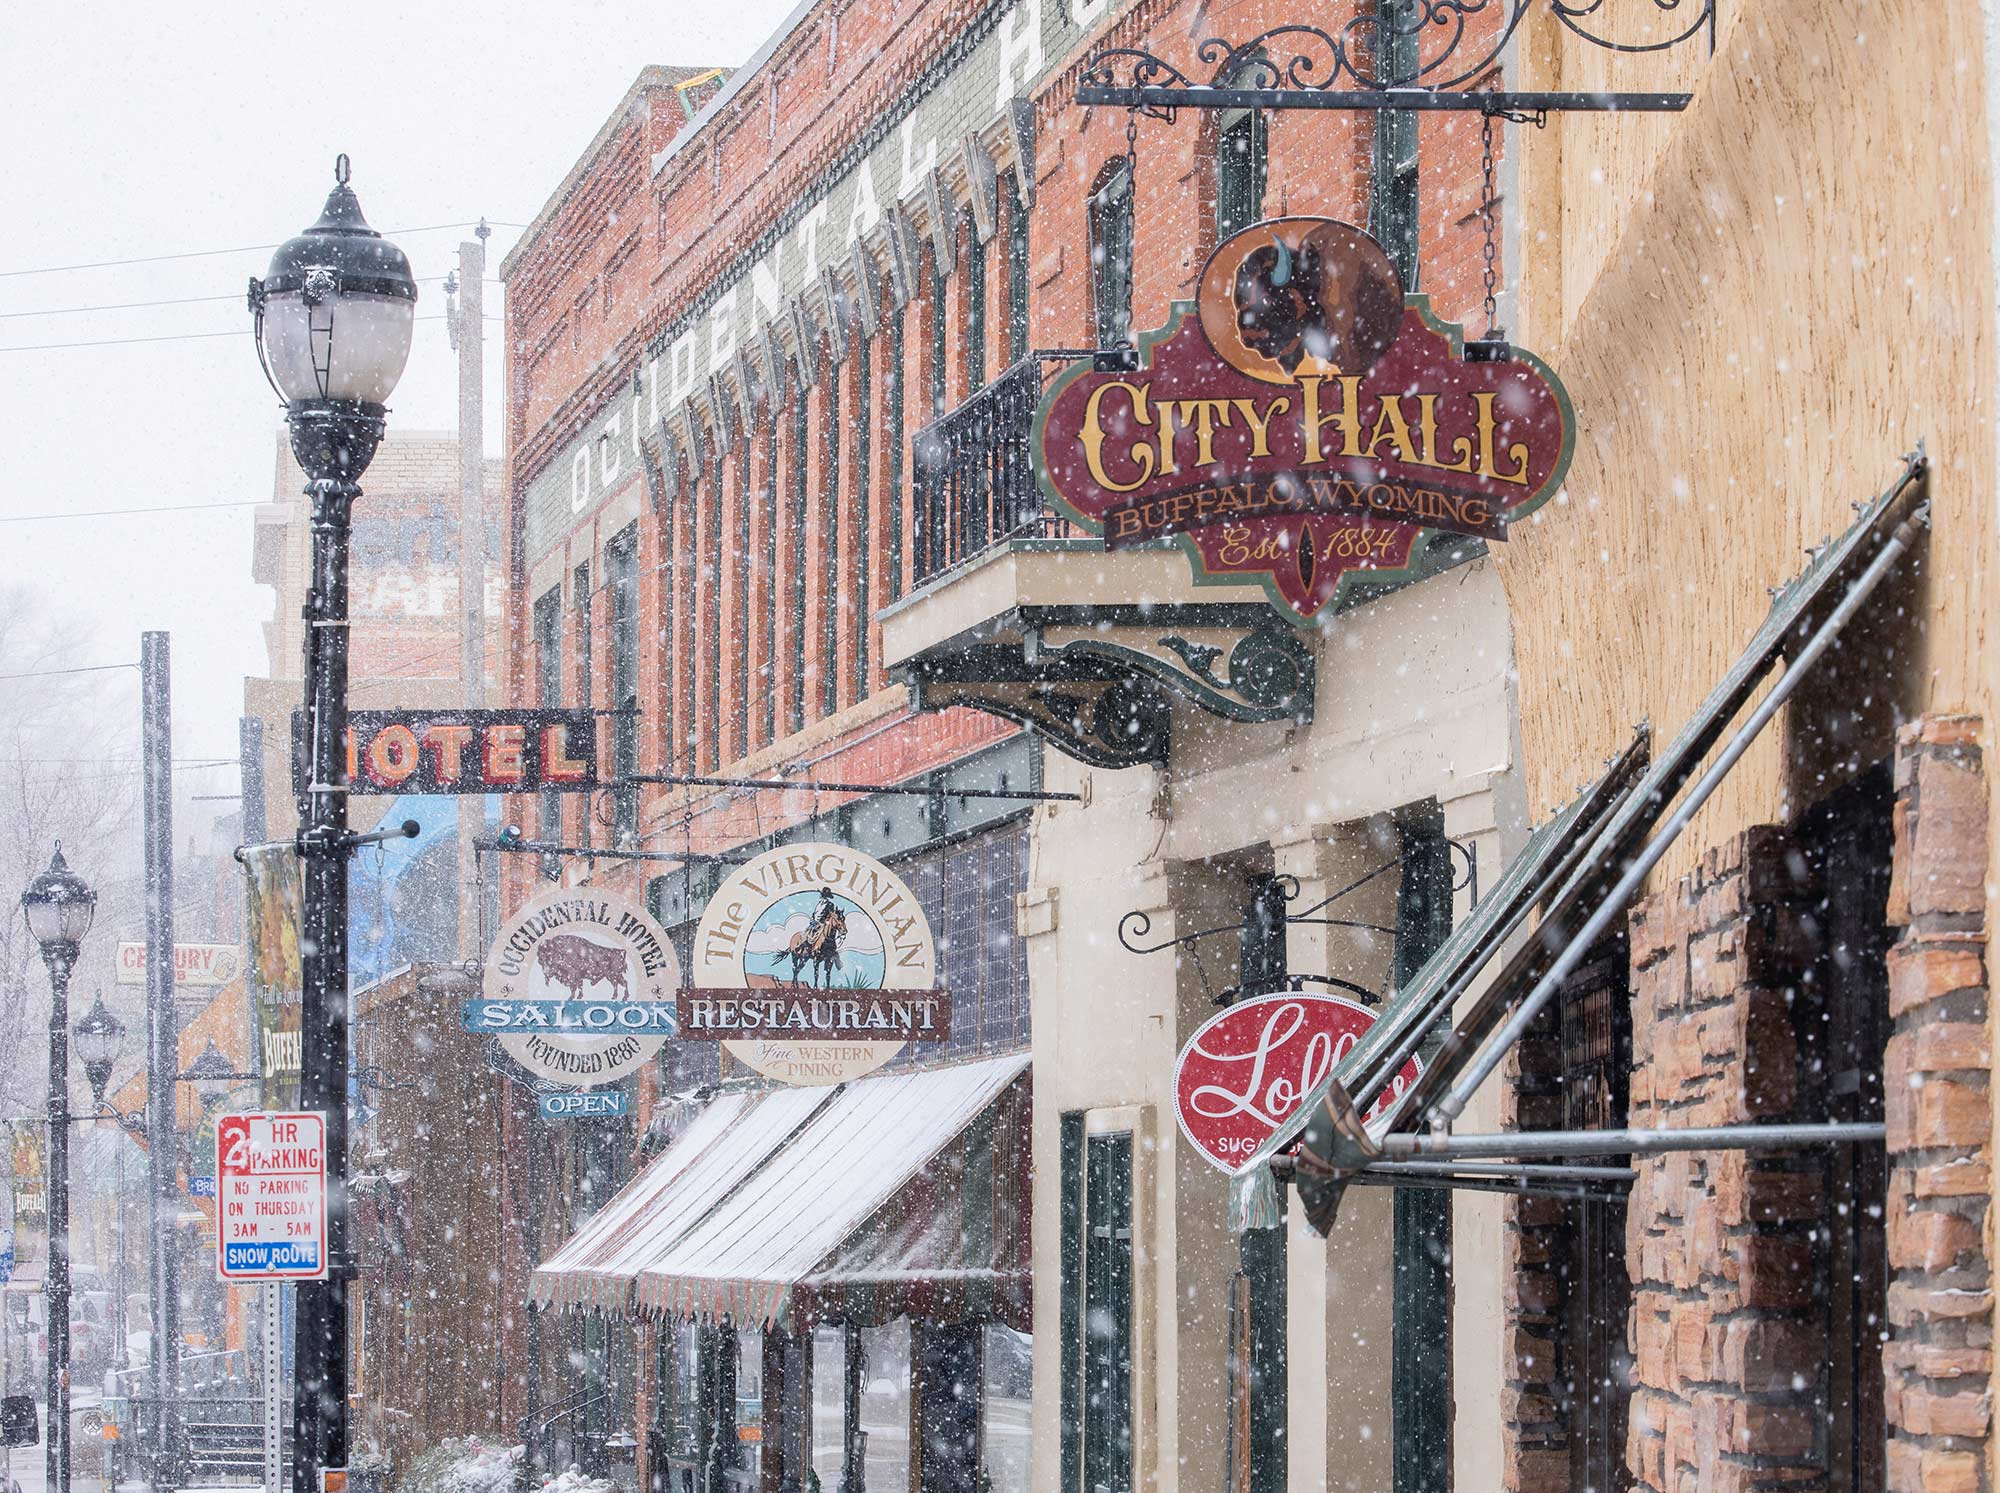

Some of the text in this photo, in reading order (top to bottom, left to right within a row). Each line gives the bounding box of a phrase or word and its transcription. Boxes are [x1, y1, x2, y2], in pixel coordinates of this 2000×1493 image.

[1077, 372, 1529, 493] CITY HALL
[1113, 478, 1493, 538] BUFFALO, WYOMING
[1219, 526, 1399, 566] Est. 1884
[347, 724, 587, 789] OTEL
[704, 853, 926, 970] The VIRGINIAN
[498, 899, 667, 979] OCCIDENTAL HOTEL
[122, 946, 214, 970] CEURY
[482, 1004, 677, 1028] SALOON
[687, 998, 940, 1031] RESTAURANT
[262, 1026, 302, 1078] BUFFA
[525, 1034, 602, 1074] FOUNDED
[604, 1036, 641, 1070] 1880
[758, 1042, 874, 1062] Fine WESTERN
[787, 1062, 844, 1077] DINING
[545, 1093, 621, 1114] OPEN
[224, 1122, 298, 1170] 2 HR
[251, 1147, 319, 1170] PARKING
[234, 1179, 310, 1196] NO PARKING
[15, 1191, 47, 1215] BUFFALO
[228, 1200, 315, 1217] ON THURSDAY
[233, 1222, 258, 1238] 3AM
[286, 1221, 312, 1237] 5AM
[228, 1245, 317, 1266] SNOW ROUTE
